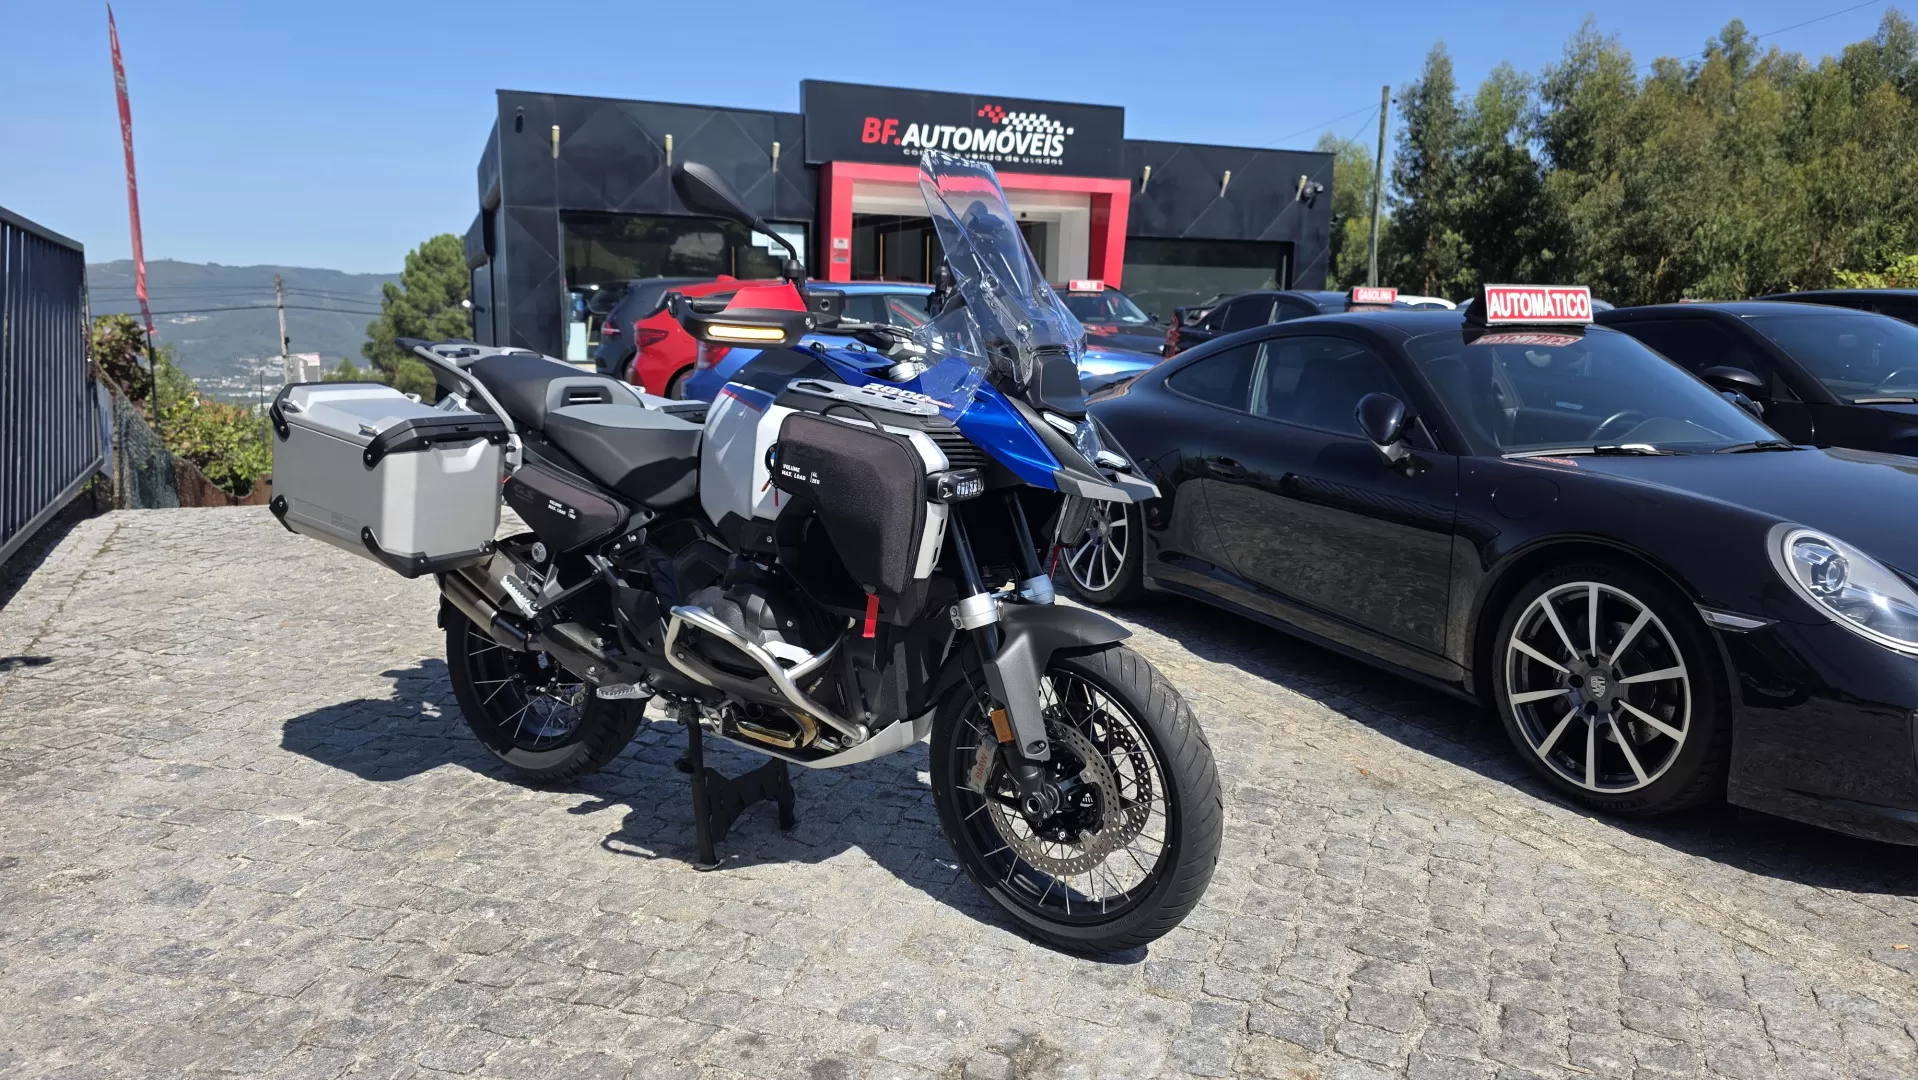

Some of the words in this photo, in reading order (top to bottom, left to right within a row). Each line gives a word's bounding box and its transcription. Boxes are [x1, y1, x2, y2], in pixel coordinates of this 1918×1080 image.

[965, 152, 1002, 162] venda
[1005, 154, 1019, 163] de
[1022, 157, 1063, 165] usados
[1358, 289, 1392, 301] GASOLINA
[1490, 289, 1589, 317] AUTOMÁTICO
[783, 463, 801, 473] VOLUME
[794, 473, 806, 481] LOAD
[975, 752, 988, 780] BMW
